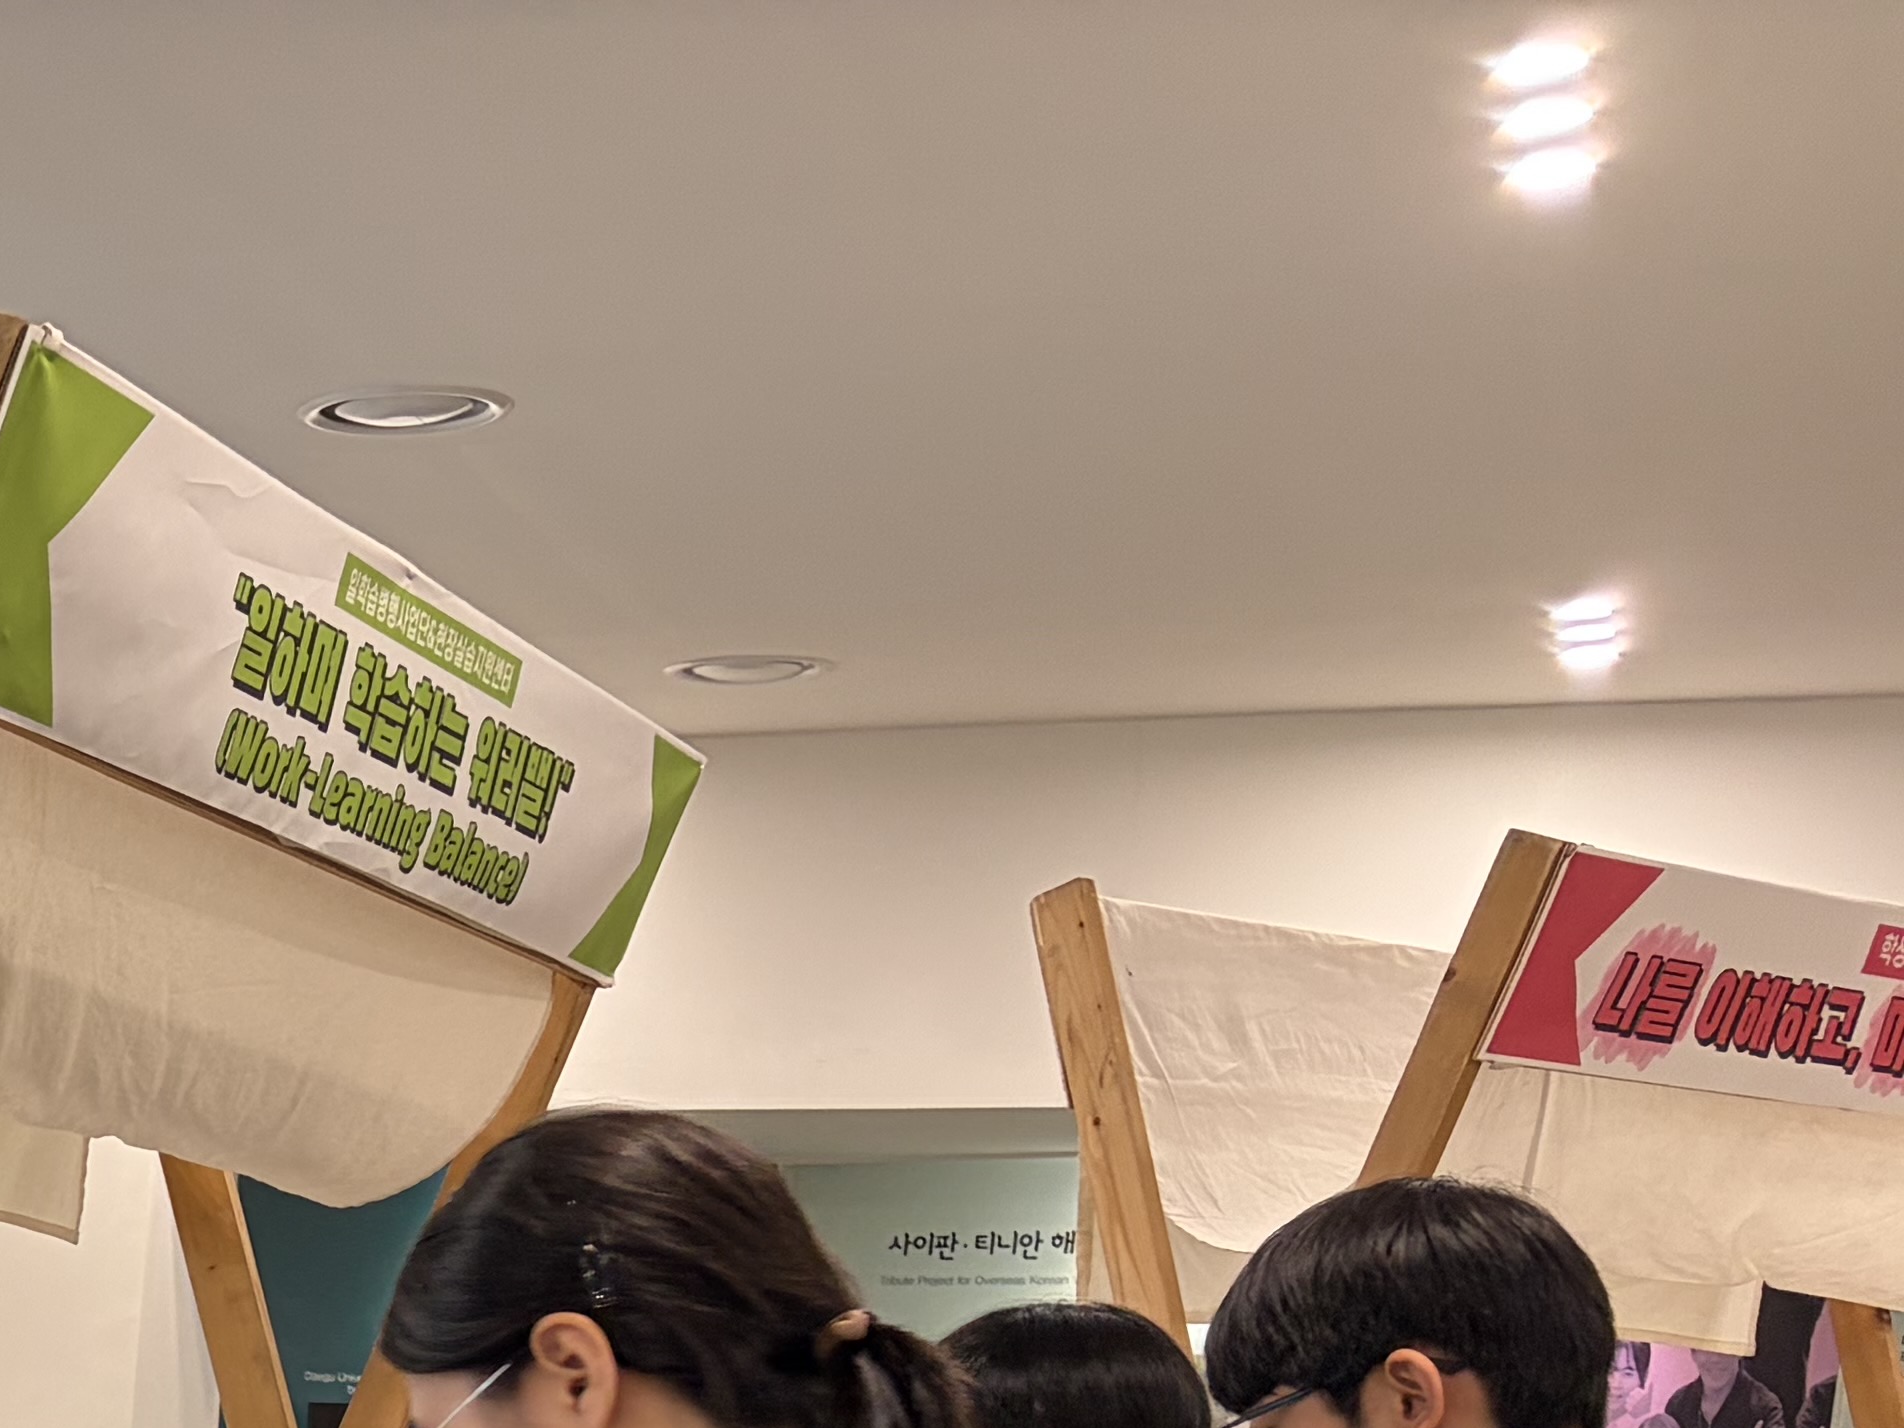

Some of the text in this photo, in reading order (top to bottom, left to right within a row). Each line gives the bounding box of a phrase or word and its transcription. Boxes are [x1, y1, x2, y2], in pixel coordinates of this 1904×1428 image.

[232, 572, 348, 732] "일하며
[343, 642, 469, 796] 학습하는
[215, 708, 529, 905] (Work-Learning Balance)
[1593, 951, 1704, 1043] 나를
[1695, 967, 1865, 1076] 이해하고,
